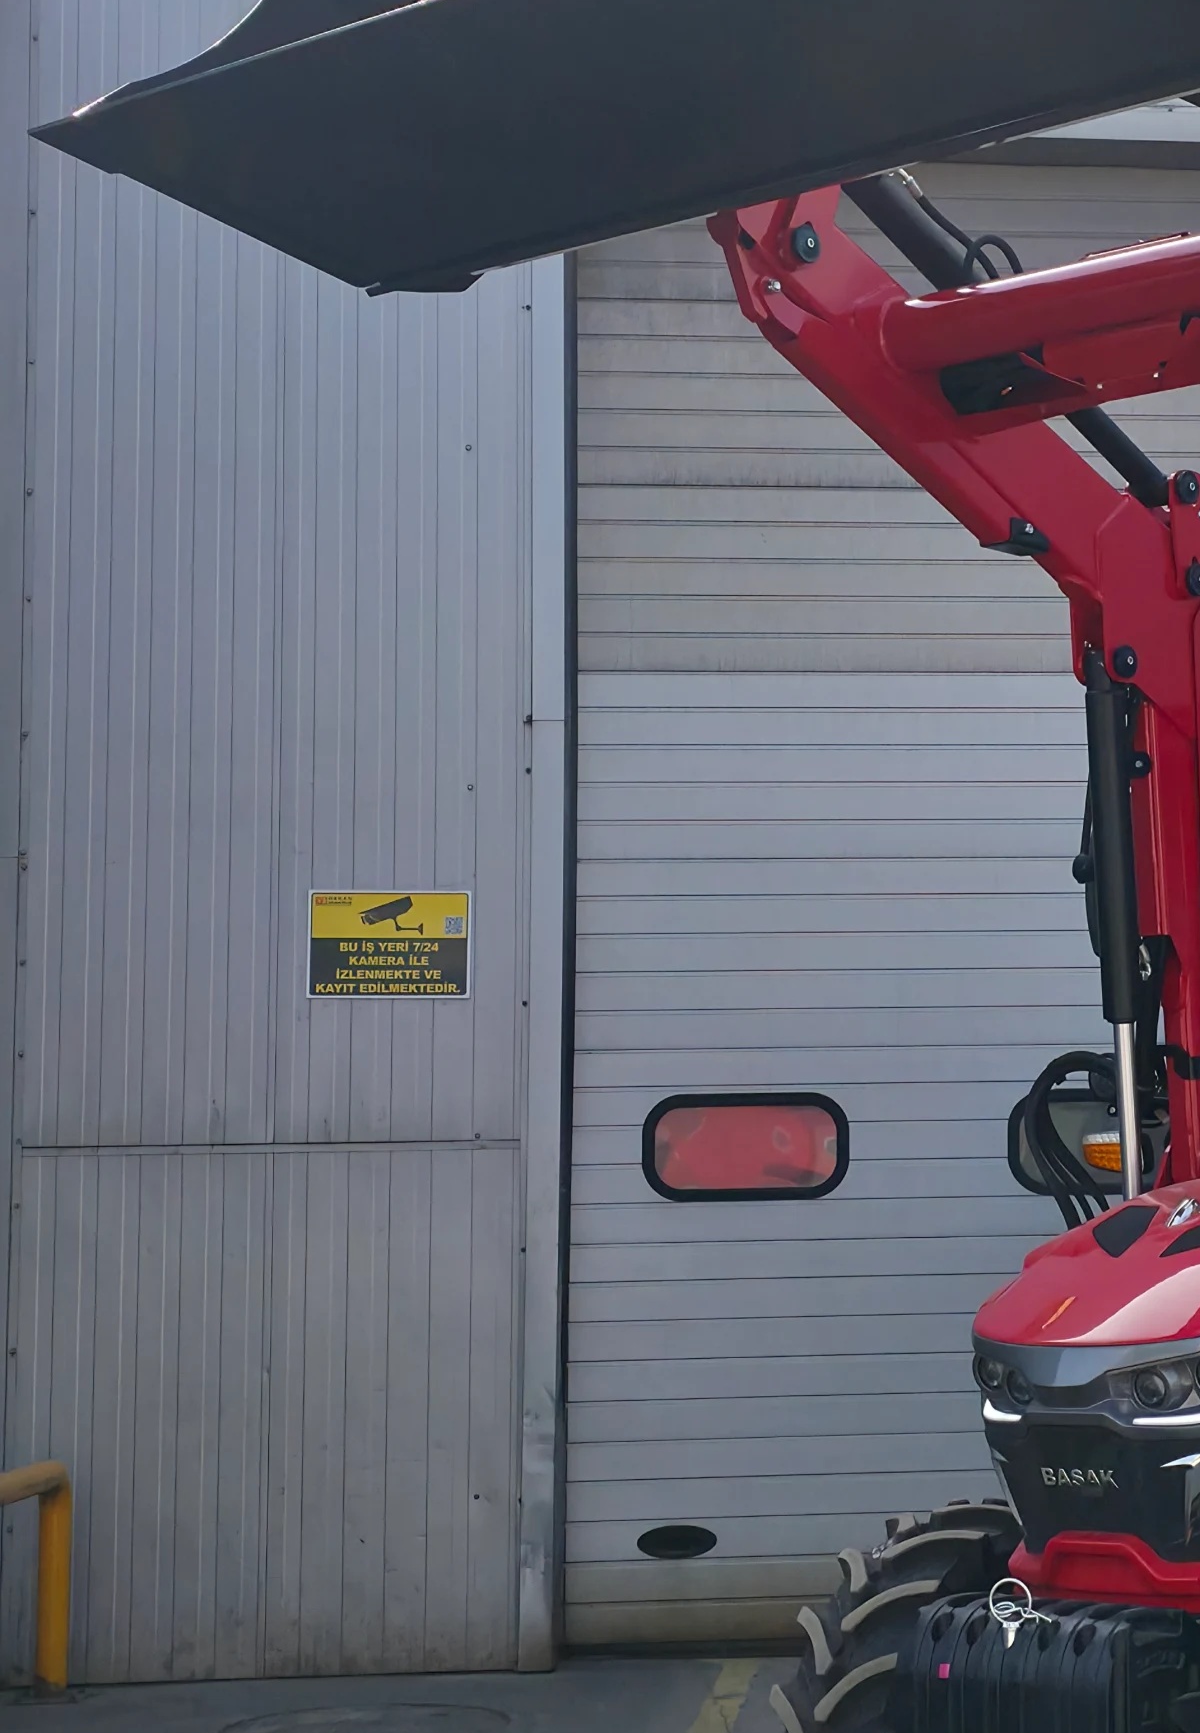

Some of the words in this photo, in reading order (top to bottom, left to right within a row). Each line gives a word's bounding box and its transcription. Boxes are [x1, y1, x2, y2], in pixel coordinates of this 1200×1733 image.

[339, 942, 358, 952] BU
[362, 940, 375, 954] İŞ
[378, 940, 409, 952] YERİ
[413, 942, 439, 952] 7/24
[348, 956, 405, 966] KAMERA
[409, 954, 430, 966] İLE
[336, 968, 421, 980] İZLENMEKTE
[424, 970, 442, 980] VE
[315, 983, 356, 993] KAYIT
[359, 981, 461, 993] EDİLMEKTEDİR.
[1040, 1467, 1120, 1489] BASAK
